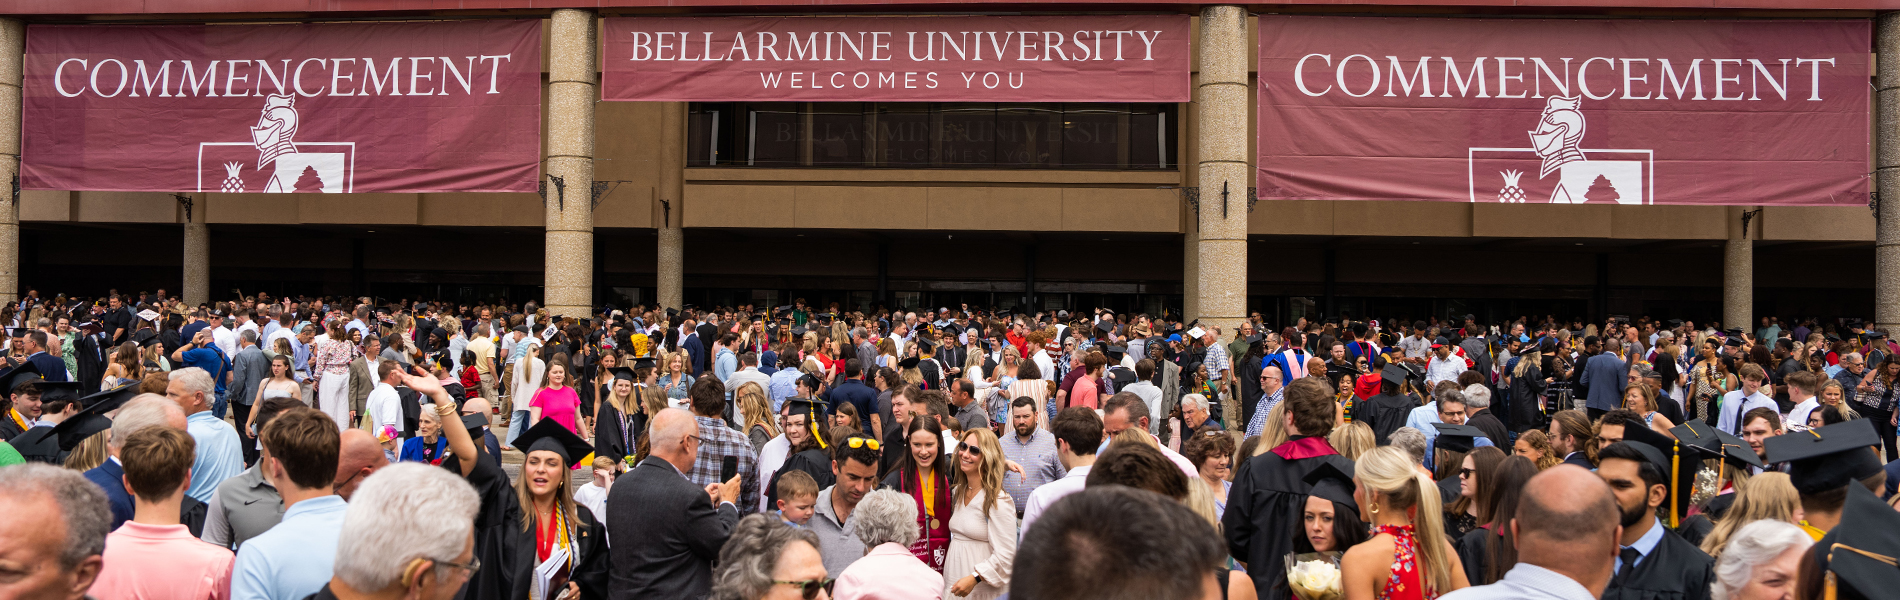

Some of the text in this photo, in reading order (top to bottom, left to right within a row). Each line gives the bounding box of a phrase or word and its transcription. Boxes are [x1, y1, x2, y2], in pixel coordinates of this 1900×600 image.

[630, 30, 1162, 62] BELLARMINE UNIVERSITY
[54, 53, 511, 98] COMMENCEMENT
[760, 71, 1024, 89] WELCOMES YOU
[1294, 53, 1835, 101] COMMENCEMENT
[862, 149, 987, 161] WELCOMES
